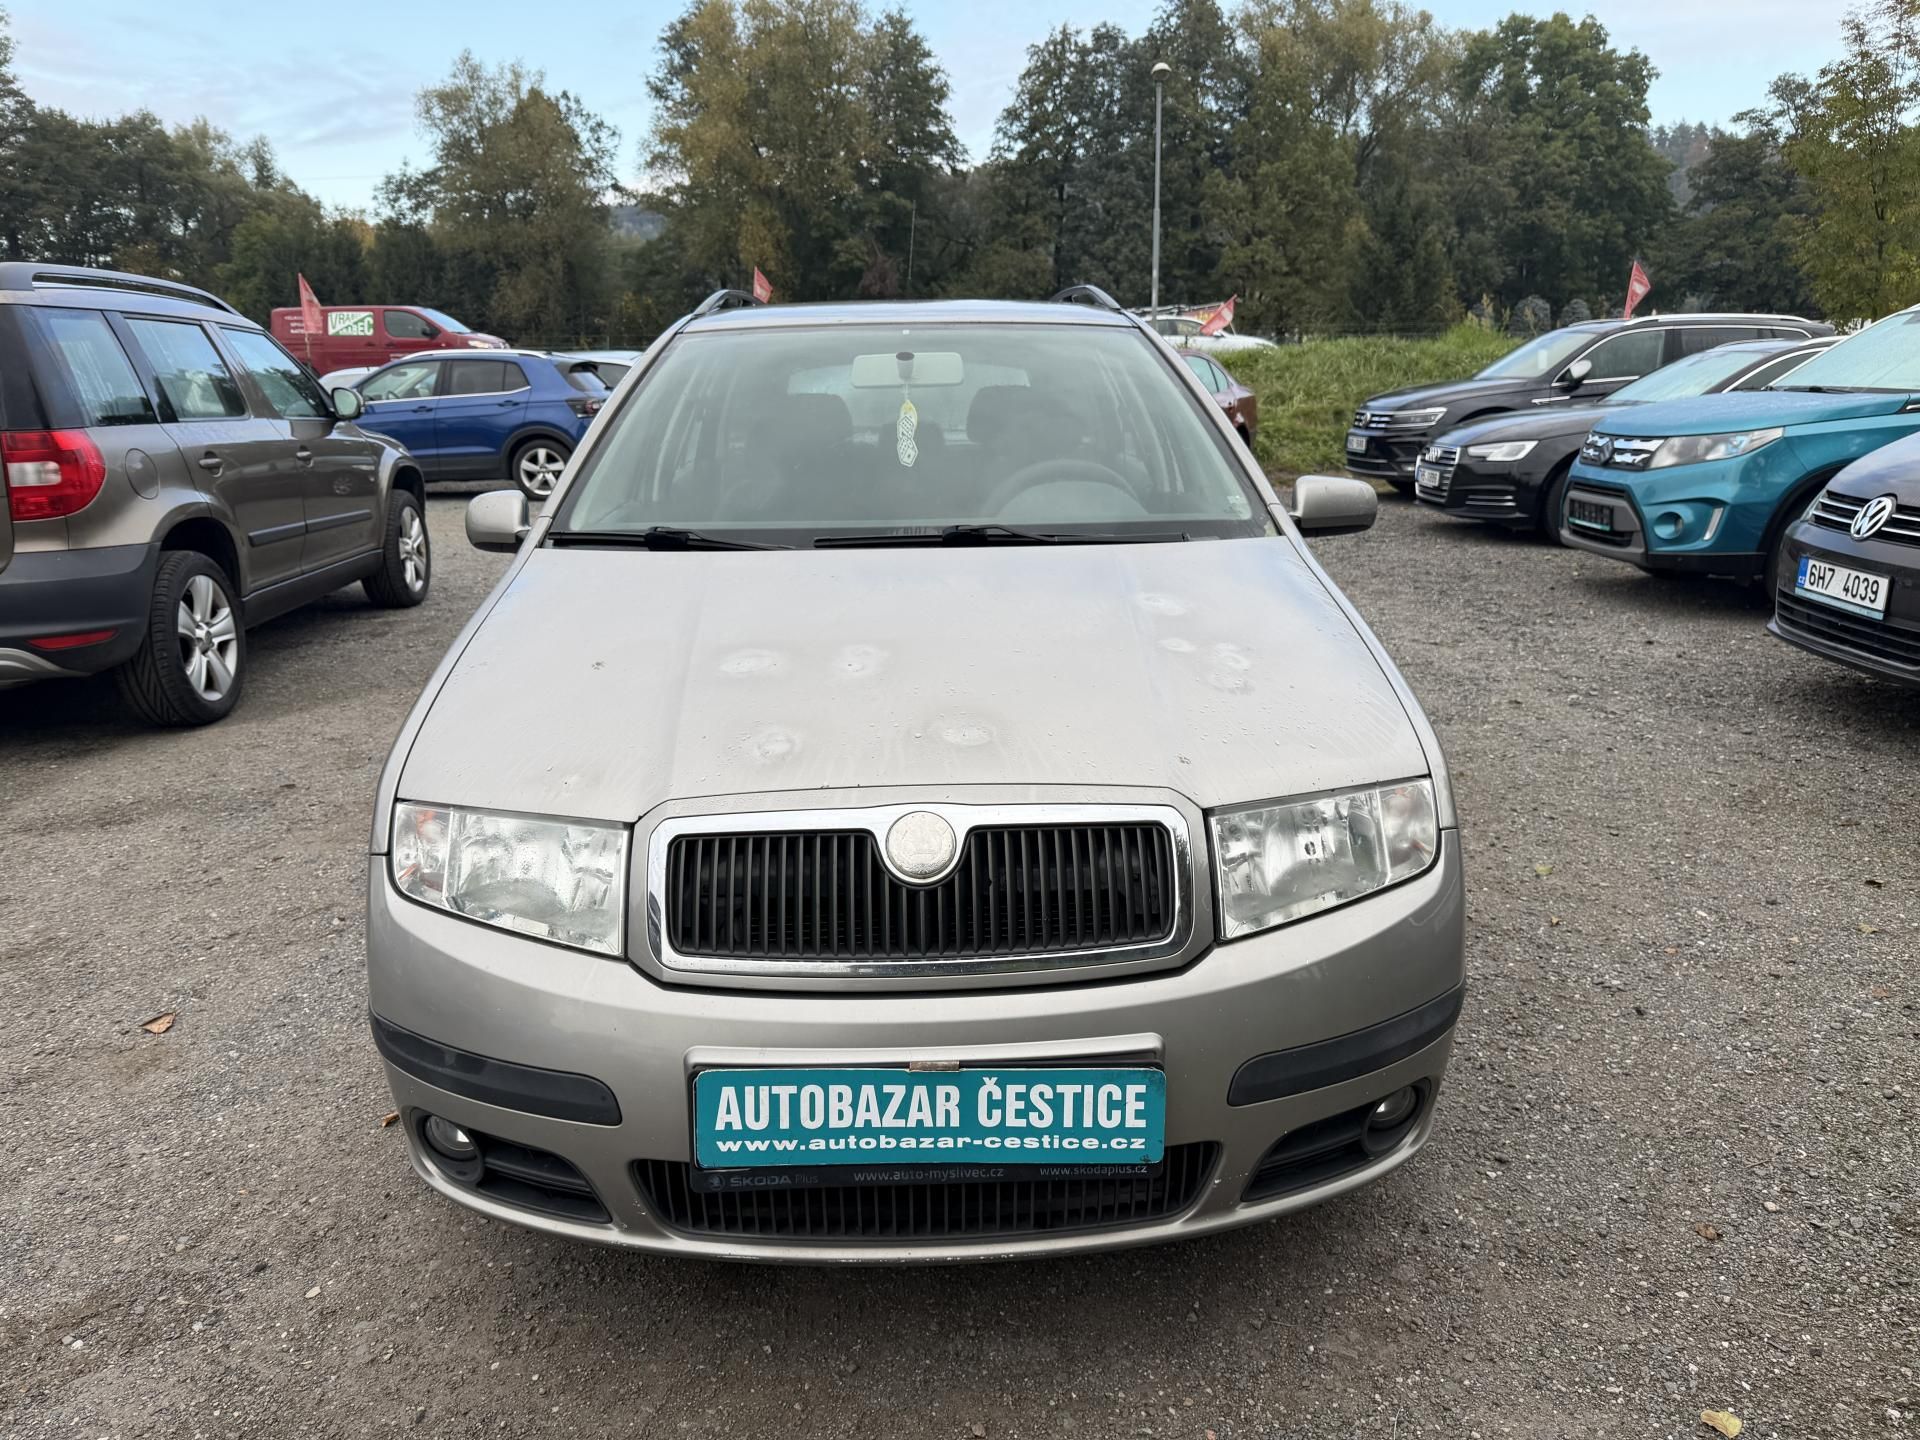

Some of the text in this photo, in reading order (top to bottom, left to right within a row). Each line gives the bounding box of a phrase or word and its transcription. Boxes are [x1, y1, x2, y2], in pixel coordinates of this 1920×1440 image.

[1808, 564, 1879, 604] 6H7 4039
[715, 1076, 1147, 1131] AUTOBAZAR ČESTICE
[716, 1134, 1146, 1152] www.autobazar-cestice.cz
[853, 1166, 1004, 1182] www.auto-myslivec.cz
